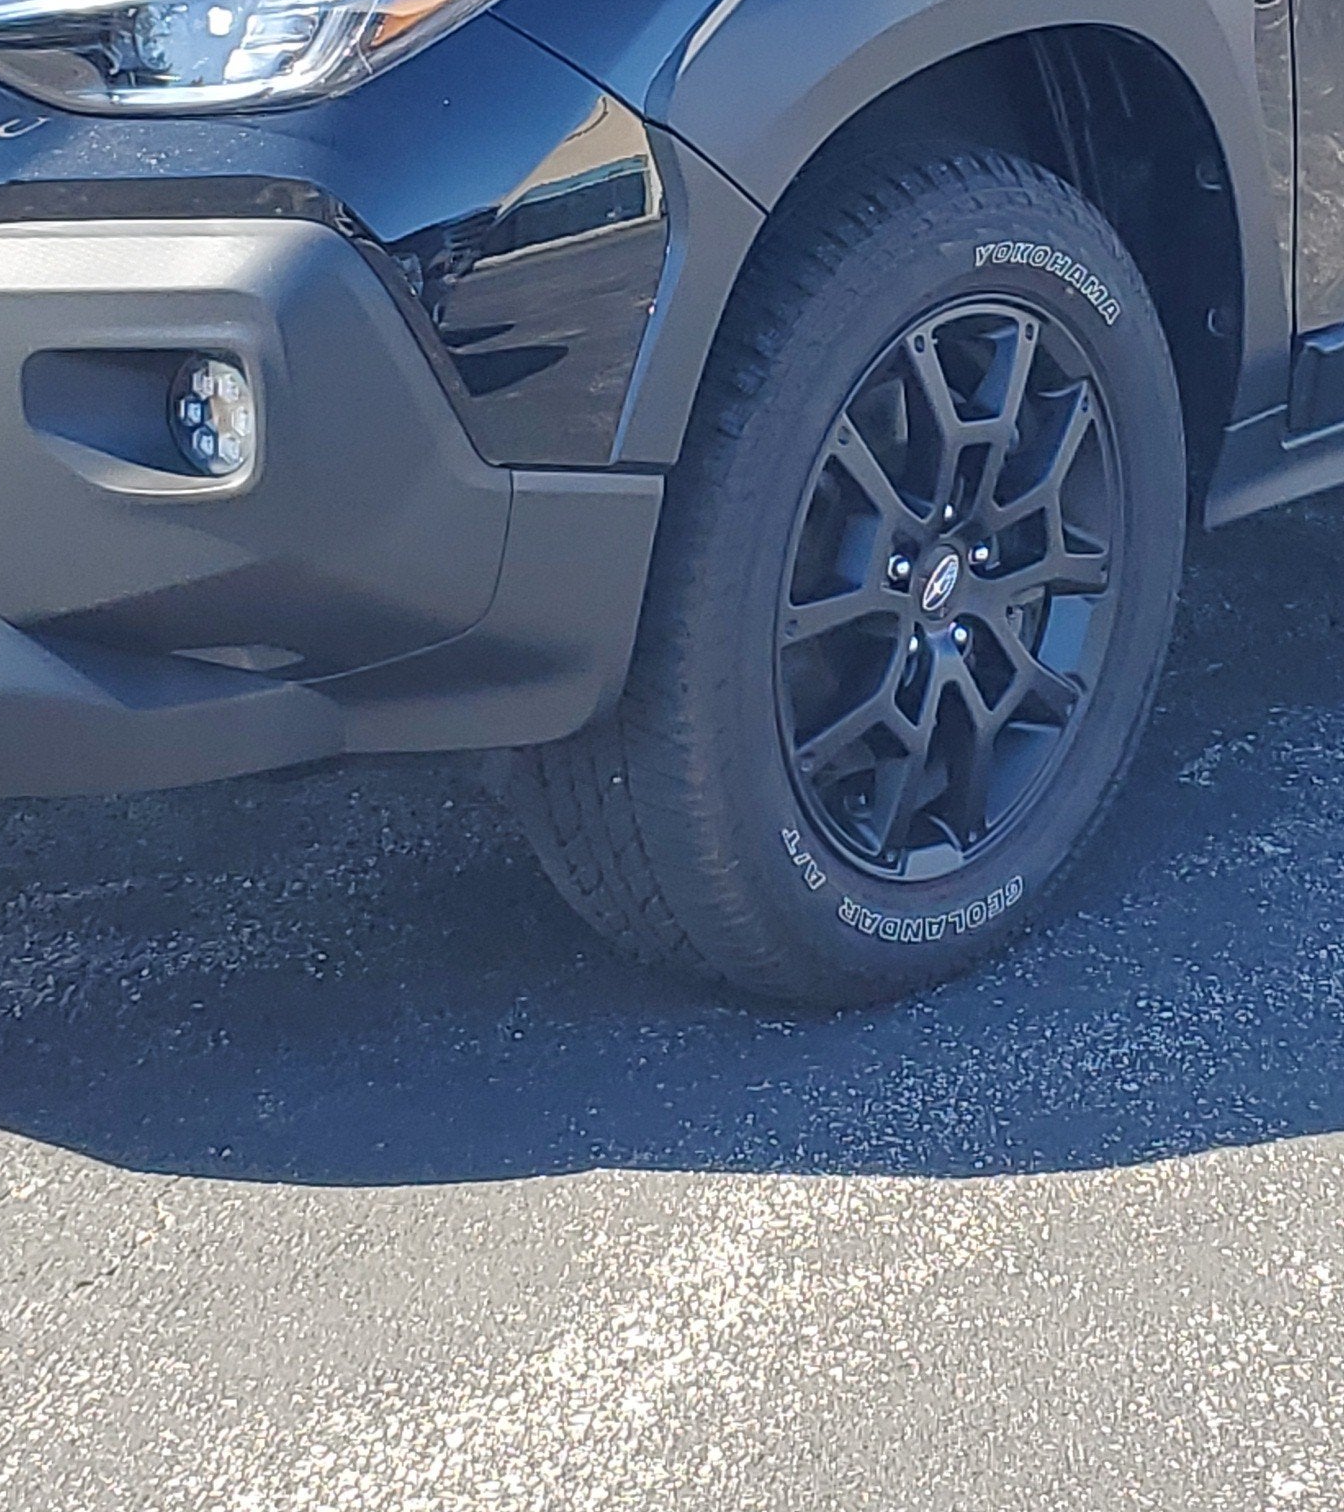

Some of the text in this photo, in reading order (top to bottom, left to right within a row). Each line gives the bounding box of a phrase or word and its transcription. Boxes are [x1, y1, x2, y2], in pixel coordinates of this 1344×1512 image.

[974, 240, 1122, 326] YOKOHAMA
[780, 826, 1025, 943] GEOLANDAR A/T
